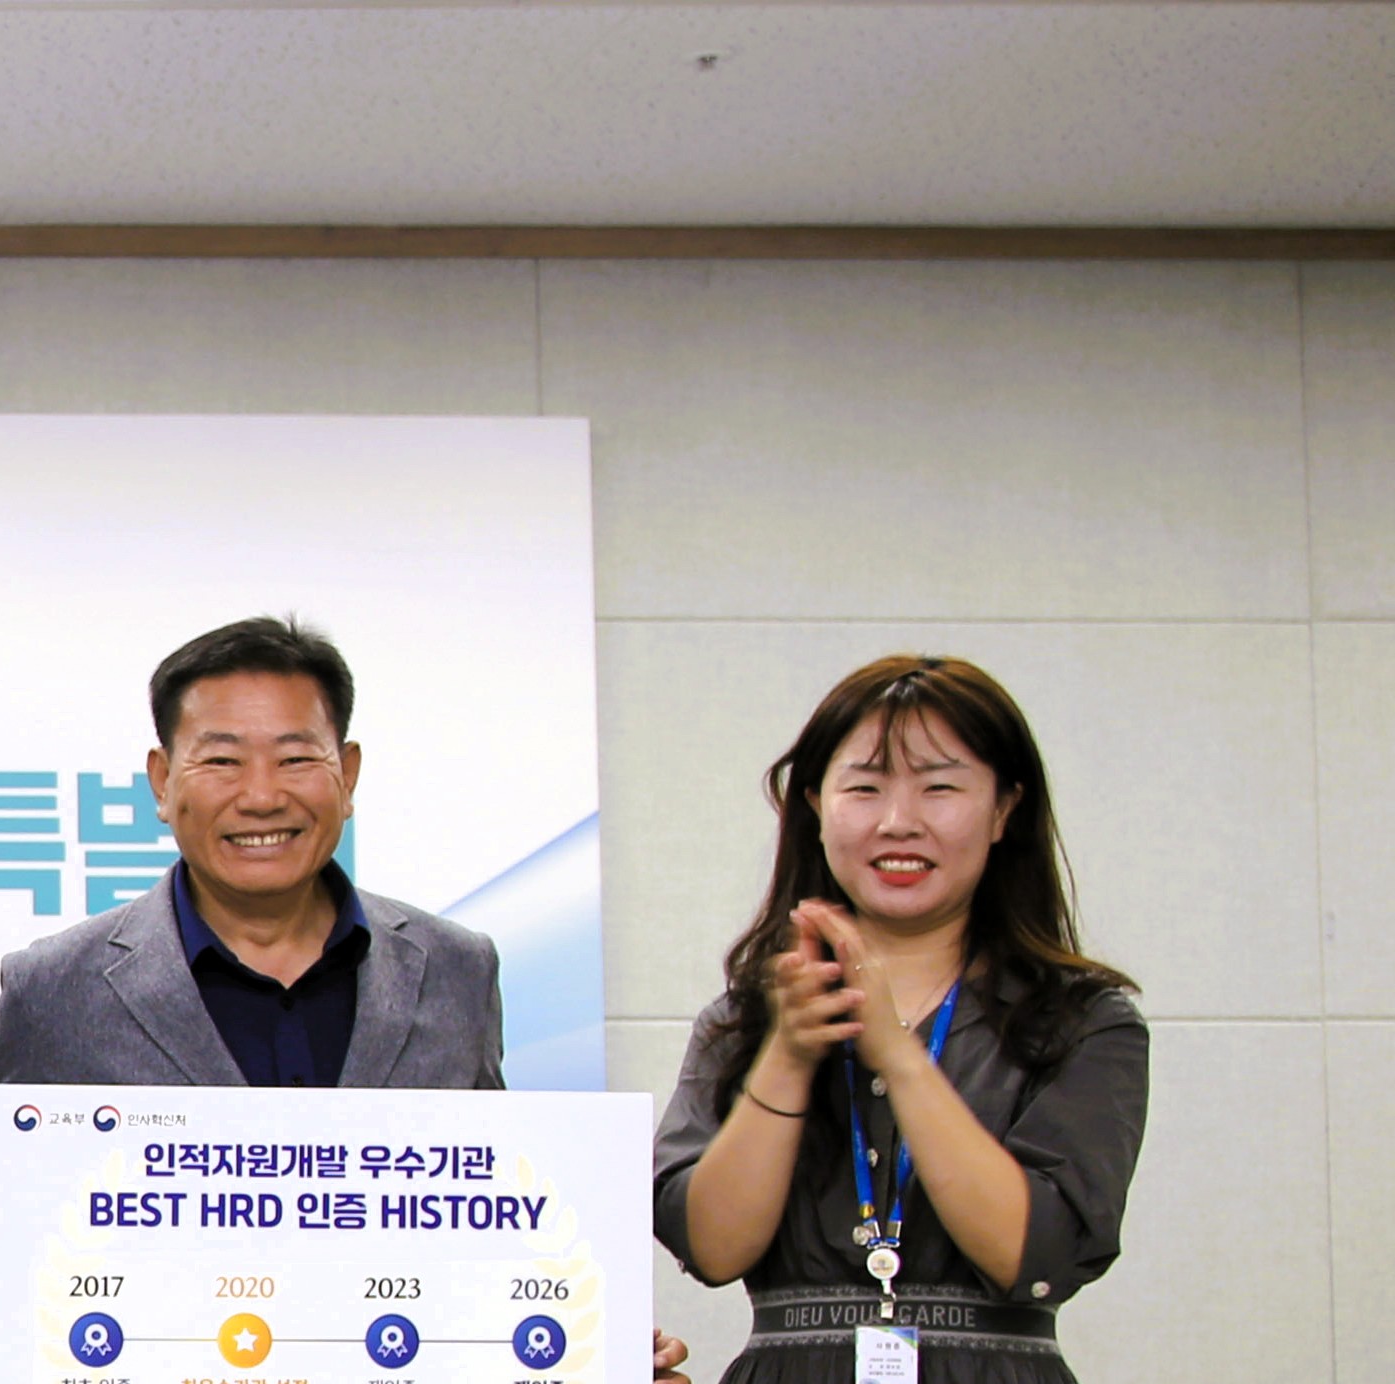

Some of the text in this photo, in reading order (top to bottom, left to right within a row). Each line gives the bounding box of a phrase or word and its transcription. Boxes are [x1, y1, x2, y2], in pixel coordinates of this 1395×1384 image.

[50, 1113, 84, 1124] 교육부
[128, 1114, 185, 1126] 인사혁신처
[145, 1144, 495, 1179] 인적자원개발 우수기관
[90, 1192, 547, 1230] BEST HRD 인증 HISTORY
[69, 1276, 124, 1297] 2017
[216, 1277, 274, 1298] 2020
[364, 1277, 421, 1299] 2023
[510, 1279, 569, 1300] 2026
[784, 1304, 977, 1328] DIEU VOU GARDE
